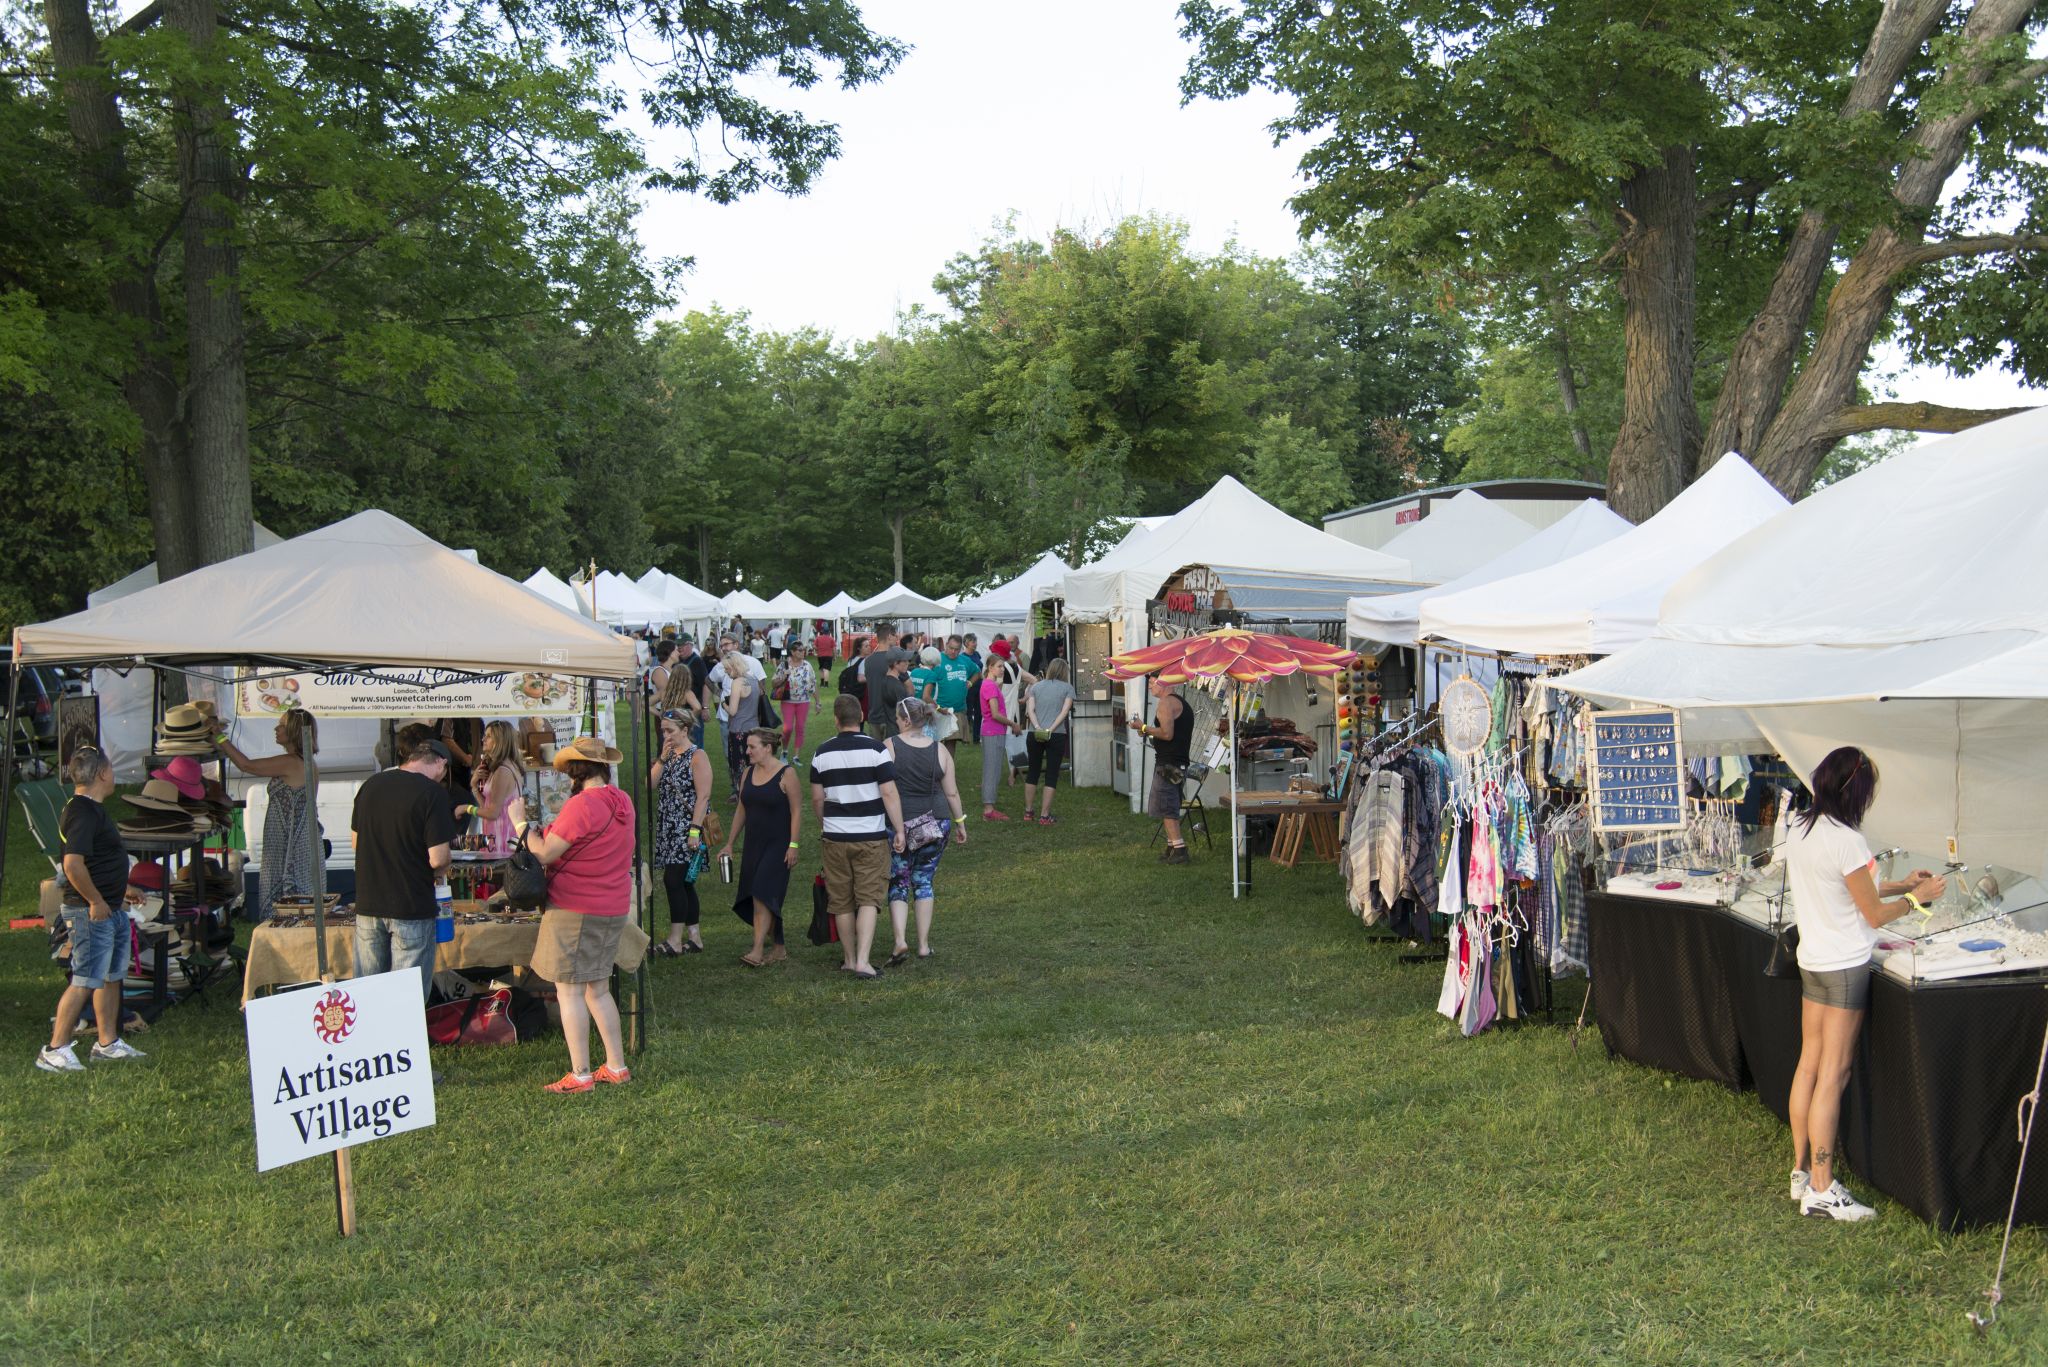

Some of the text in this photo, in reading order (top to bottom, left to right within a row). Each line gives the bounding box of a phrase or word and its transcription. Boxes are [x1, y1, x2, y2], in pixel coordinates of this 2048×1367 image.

[350, 694, 472, 704] www.sunsweetcatering.com
[273, 1048, 412, 1105] Artisans
[290, 1093, 411, 1145] Village
